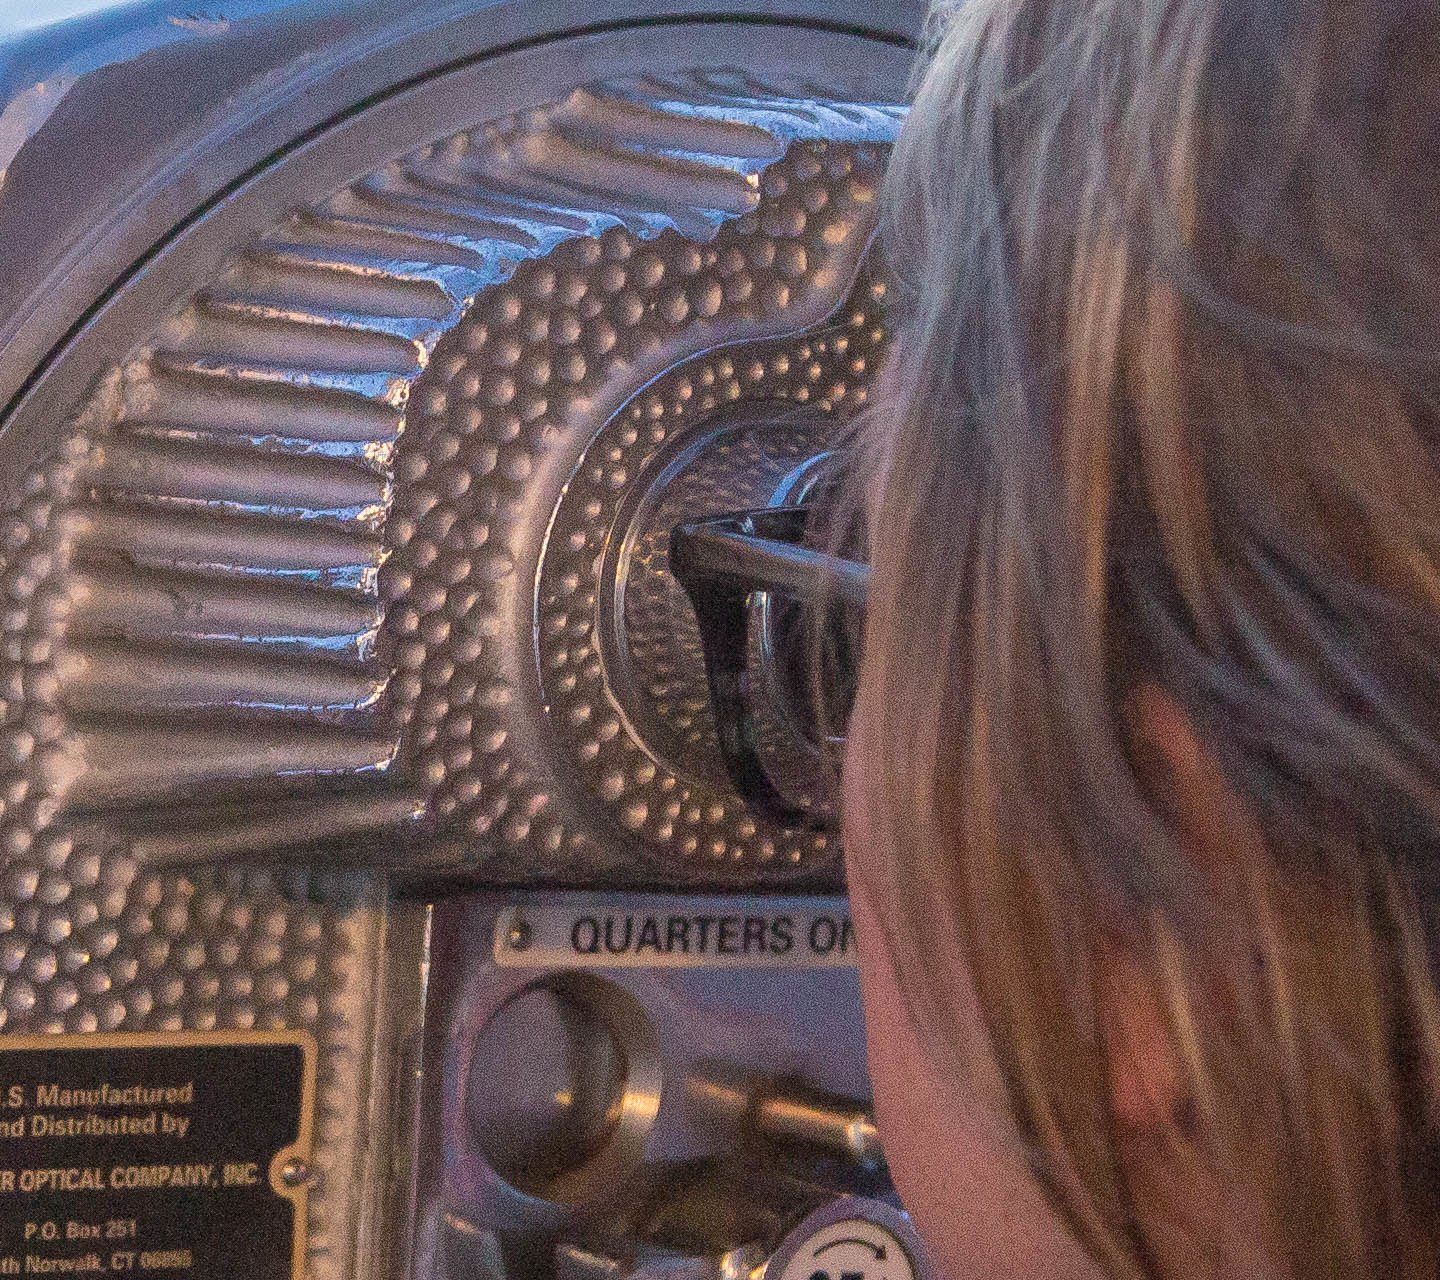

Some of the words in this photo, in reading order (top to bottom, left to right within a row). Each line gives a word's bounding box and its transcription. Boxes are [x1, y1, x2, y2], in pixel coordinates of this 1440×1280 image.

[570, 915, 795, 955] QUARTERS
[36, 1080, 194, 1106] Manufactured
[31, 1112, 157, 1138] Distributed
[162, 1112, 191, 1138] by
[19, 1167, 106, 1192] OPTICAL
[110, 1164, 219, 1189] COMPANY,
[66, 1220, 101, 1239] Box
[111, 1250, 137, 1270] CT
